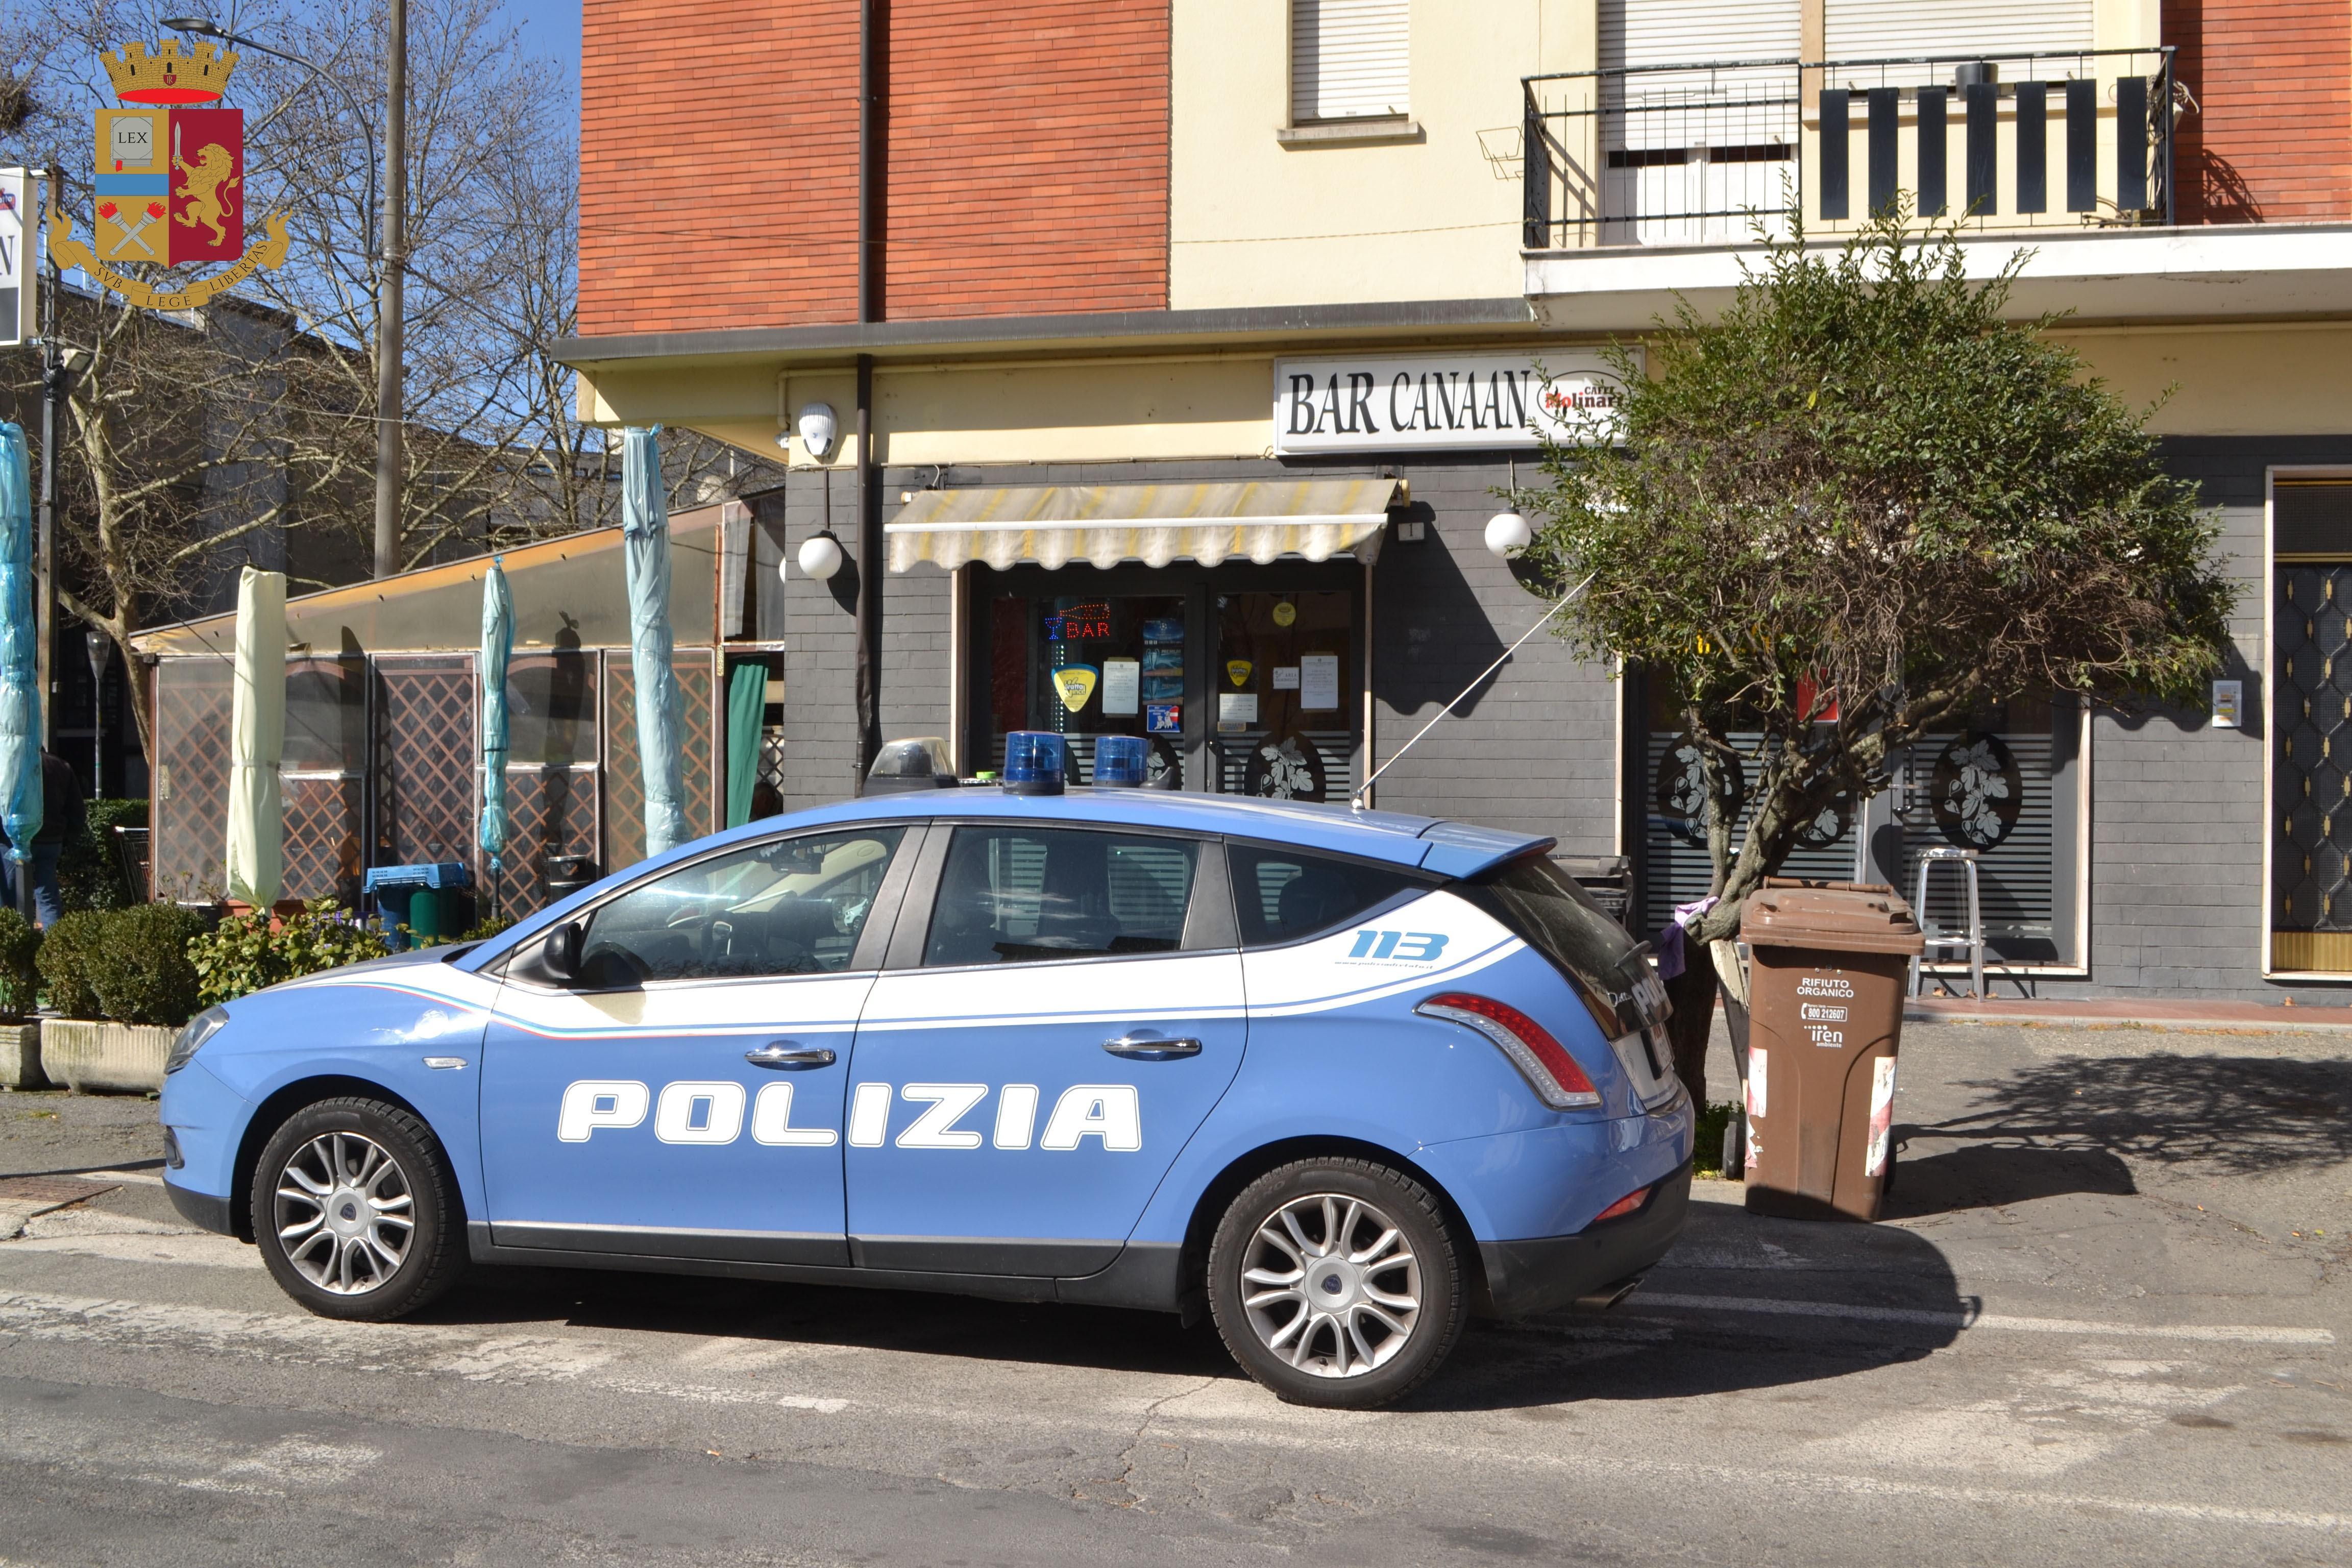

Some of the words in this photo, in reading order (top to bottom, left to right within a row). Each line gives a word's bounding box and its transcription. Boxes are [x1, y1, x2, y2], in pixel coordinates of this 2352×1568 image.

[1286, 371, 1380, 435] BAR
[1390, 370, 1531, 432] CANAAN
[1067, 622, 1111, 638] BAR
[1348, 930, 1449, 962] 113
[1802, 977, 1849, 989] RIFIUTO
[1797, 987, 1854, 998] ORGANICO
[1808, 1008, 1820, 1018] 800
[1821, 1009, 1845, 1019] 212607
[1811, 1026, 1843, 1042] iren
[557, 1080, 1142, 1152] POLIZIA
